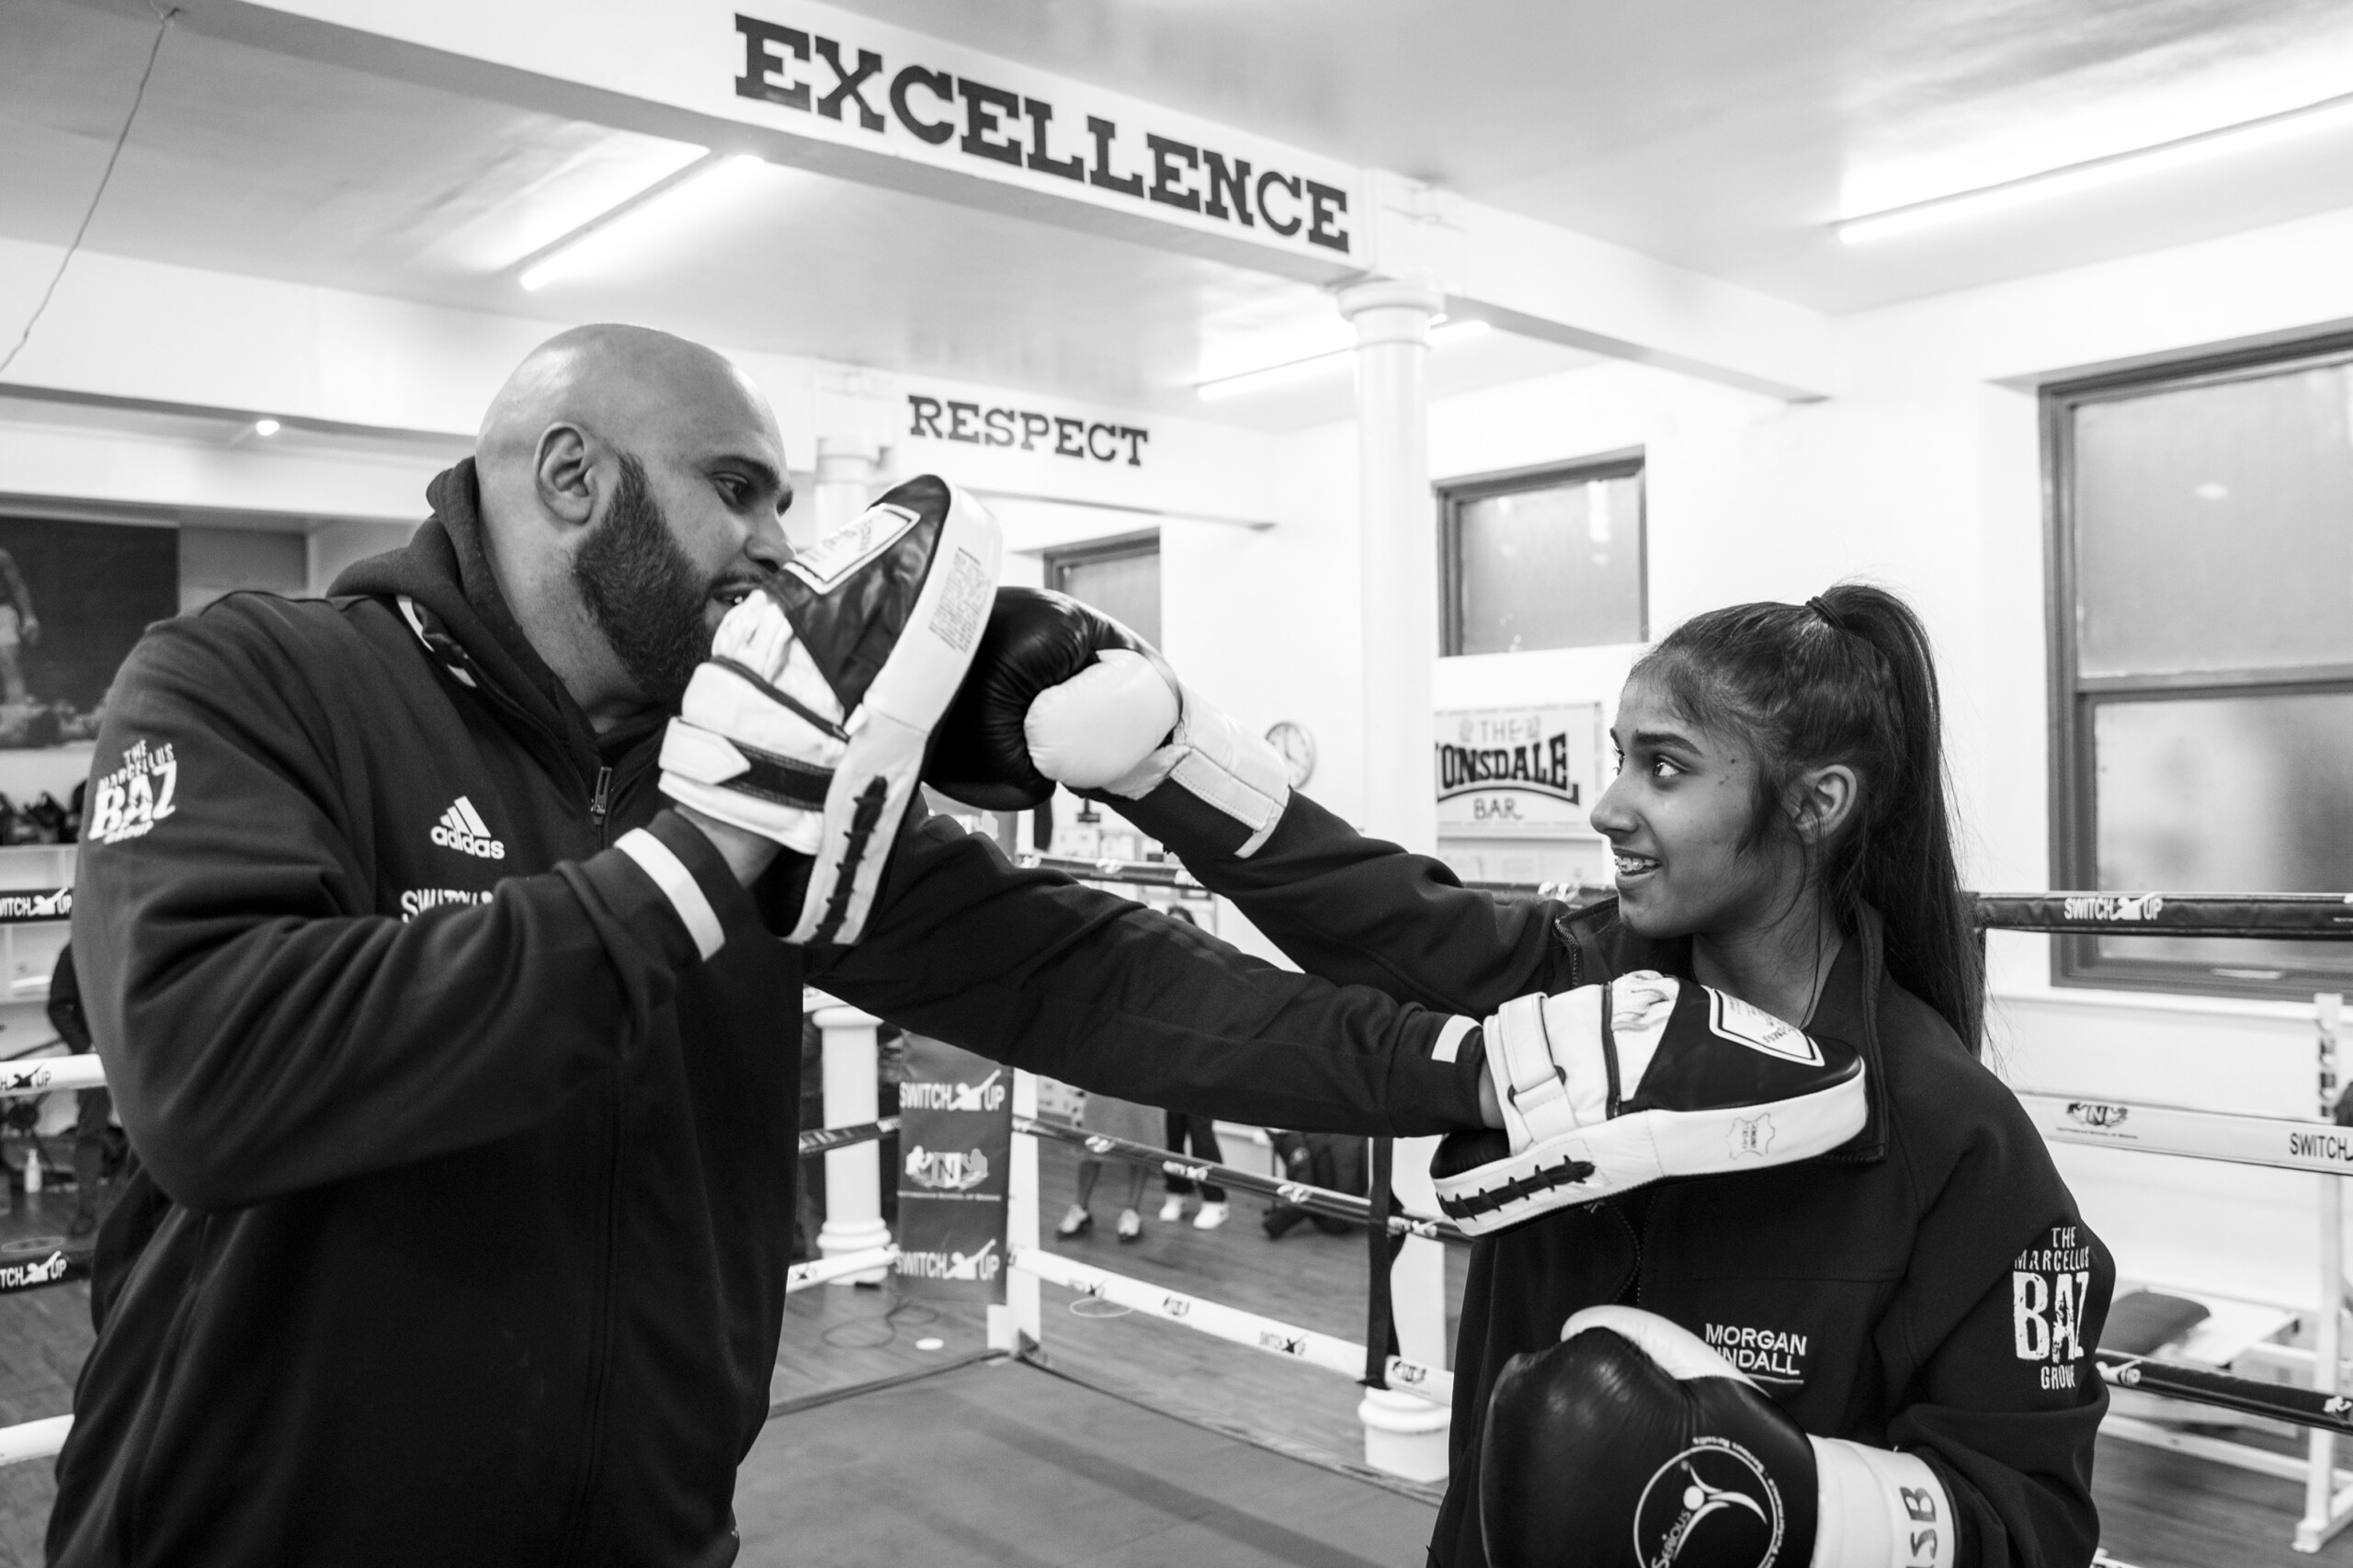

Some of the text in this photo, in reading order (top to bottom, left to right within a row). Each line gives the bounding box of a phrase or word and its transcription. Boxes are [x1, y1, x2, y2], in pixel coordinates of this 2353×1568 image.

[735, 13, 1351, 254] EXCELLENCE
[908, 394, 1149, 467] RESPECT
[1479, 718, 1523, 743] THE
[122, 739, 147, 767] THE
[1436, 731, 1568, 791] ONSDALE
[87, 759, 177, 841] BAZ
[430, 824, 506, 859] adidas
[56, 893, 73, 915] UP
[2063, 896, 2163, 921] SWITCH UP
[898, 1080, 1006, 1112] SWITCH UP
[2290, 1131, 2347, 1160] SWITCH
[2051, 1226, 2077, 1249] THE
[0, 1257, 67, 1290] TCH UP
[894, 1250, 1001, 1281] SWITCH UP
[2014, 1245, 2090, 1272] MARCELLUS
[2012, 1270, 2090, 1364] BAZ
[1705, 1323, 1808, 1357] MORGAN
[1717, 1346, 1801, 1376] NDALL
[1899, 1485, 1938, 1568] SB
